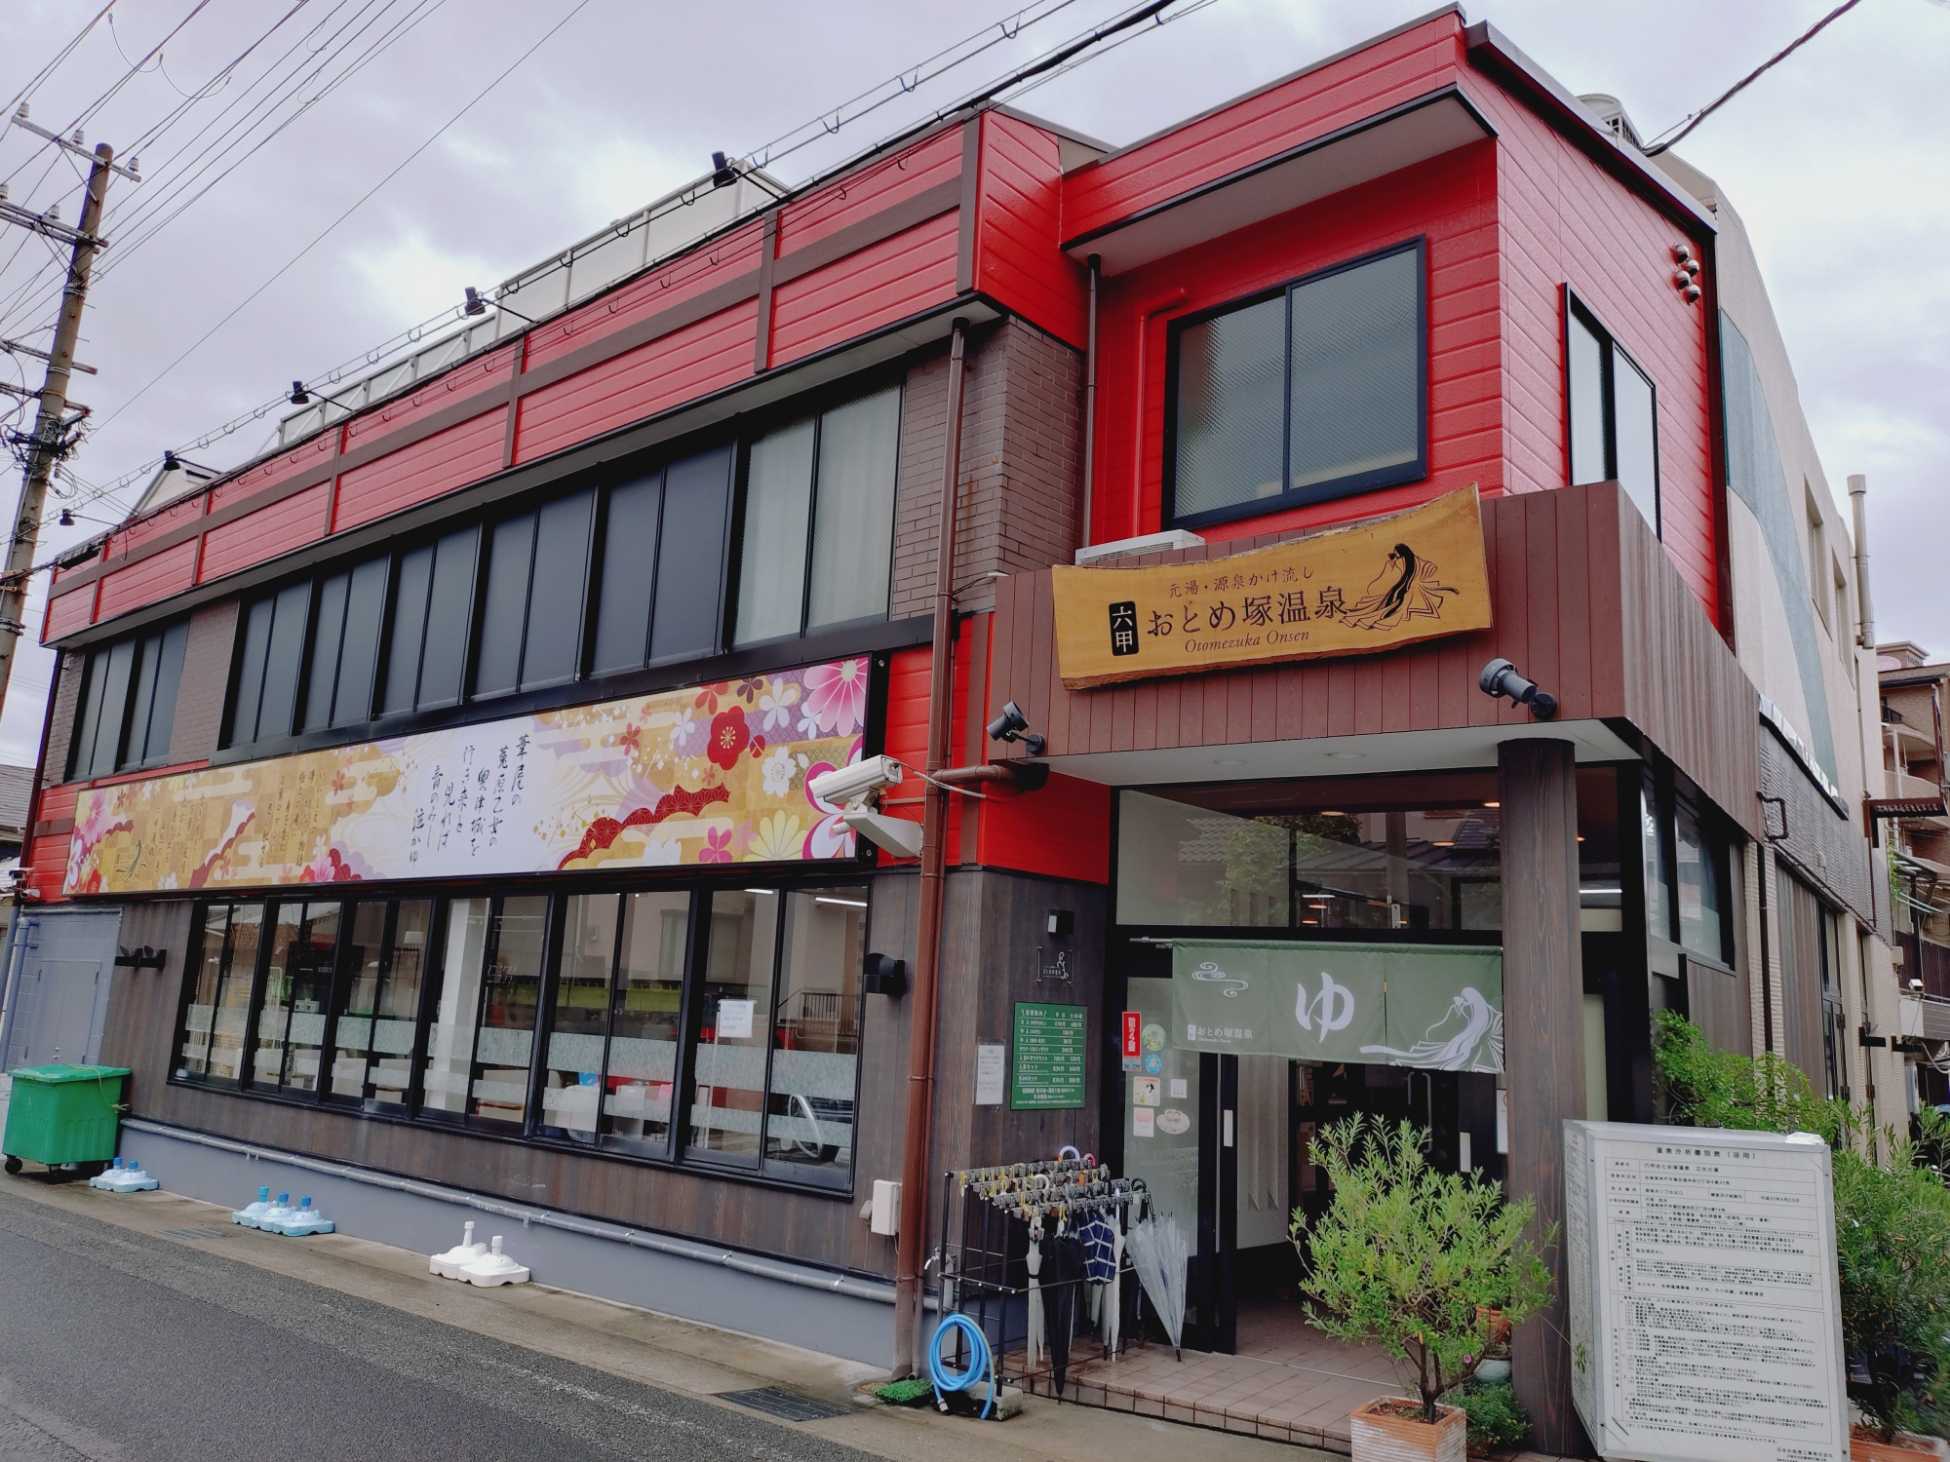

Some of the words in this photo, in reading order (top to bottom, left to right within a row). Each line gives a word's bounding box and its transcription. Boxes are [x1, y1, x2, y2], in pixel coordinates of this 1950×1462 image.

[1169, 566, 1314, 599] 元湯・源泉かけ流し
[1111, 606, 1137, 654] 六甲
[1147, 585, 1348, 637] おとめ塚温泉
[1184, 632, 1261, 653] Otomezuka
[1266, 629, 1310, 643] Onsen
[1295, 971, 1356, 1044] ゆ
